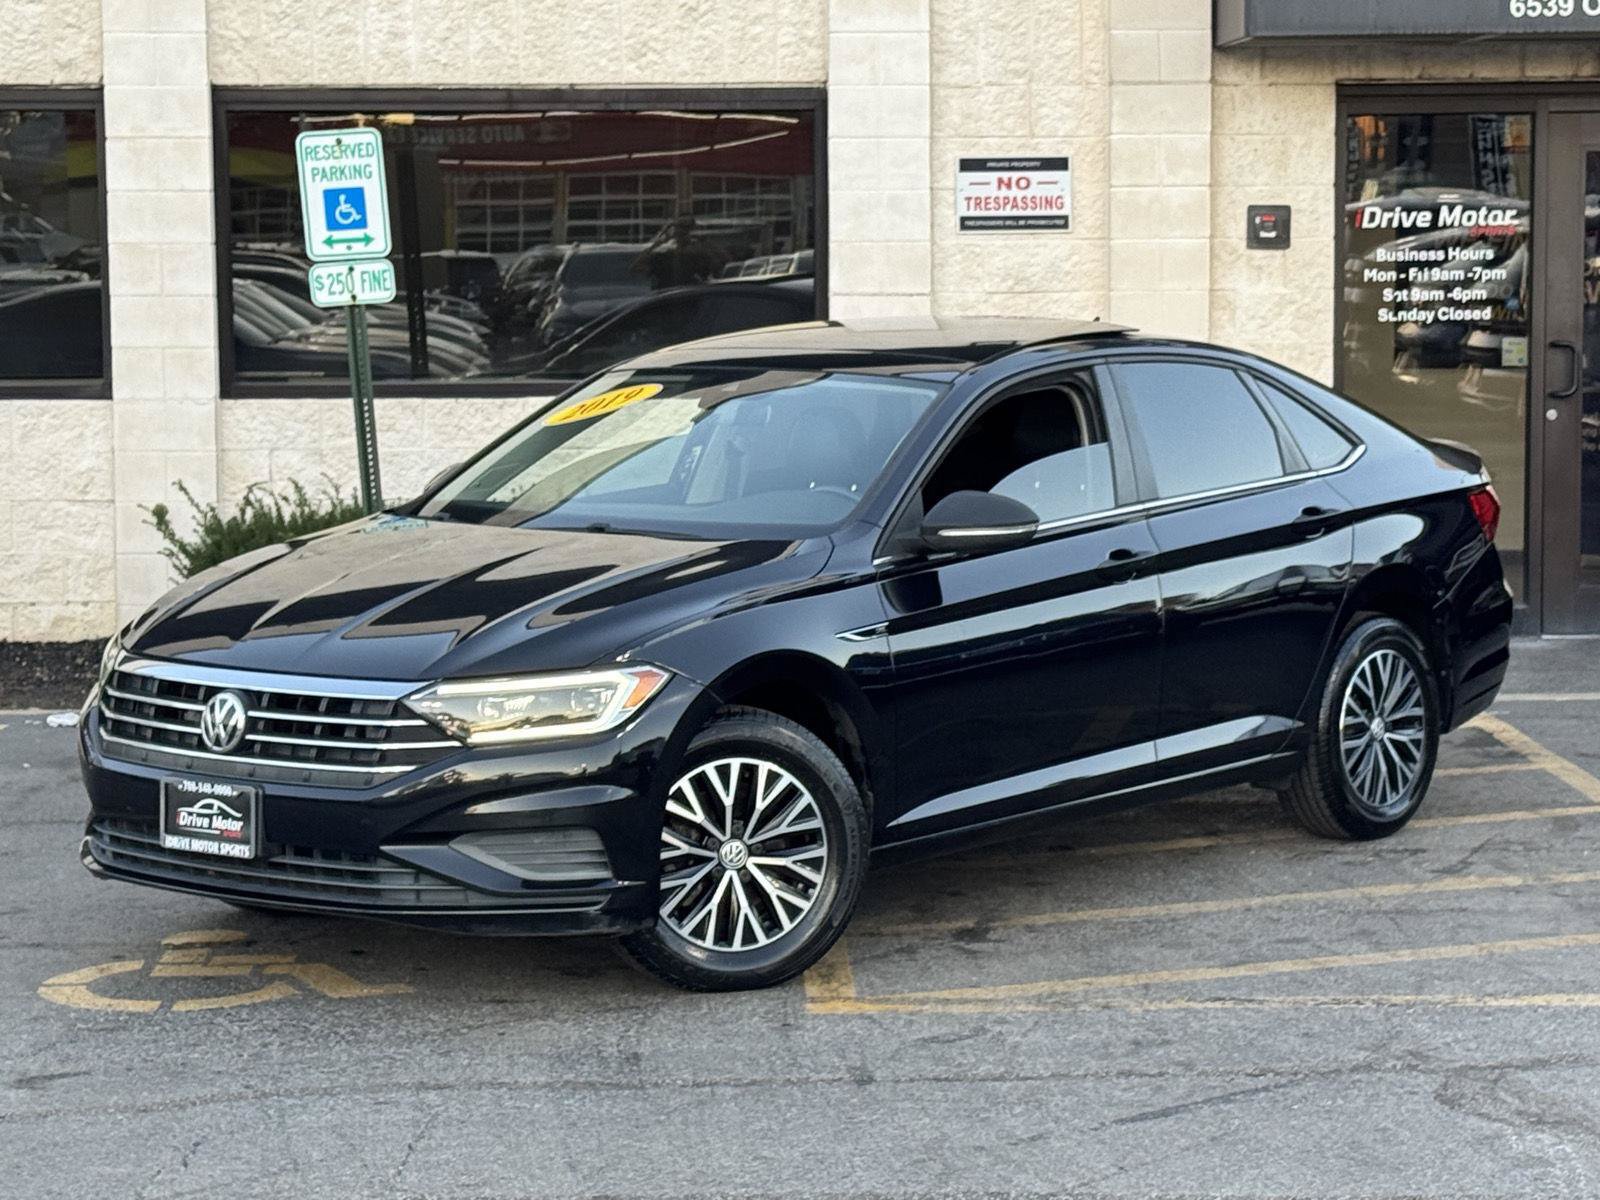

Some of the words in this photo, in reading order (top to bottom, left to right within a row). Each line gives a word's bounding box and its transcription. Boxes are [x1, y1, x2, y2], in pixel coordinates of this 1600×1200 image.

[1509, 0, 1575, 18] 6539
[304, 142, 375, 162] RESERVED
[310, 164, 373, 183] PARKING
[997, 176, 1031, 191] NO
[964, 195, 1064, 212] TRESPASSING
[1355, 206, 1433, 229] iDrive
[1376, 248, 1445, 262] Business
[1448, 247, 1494, 261] Hours
[314, 271, 355, 295] $250
[360, 269, 391, 293] FINE
[1363, 268, 1397, 283] Mon
[1382, 287, 1408, 302] Sat
[1410, 287, 1445, 301] 9am
[1377, 307, 1436, 324] Sunday
[1437, 306, 1493, 322] Closed
[211, 815, 244, 832] Motor
[190, 839, 219, 854] MOTOR
